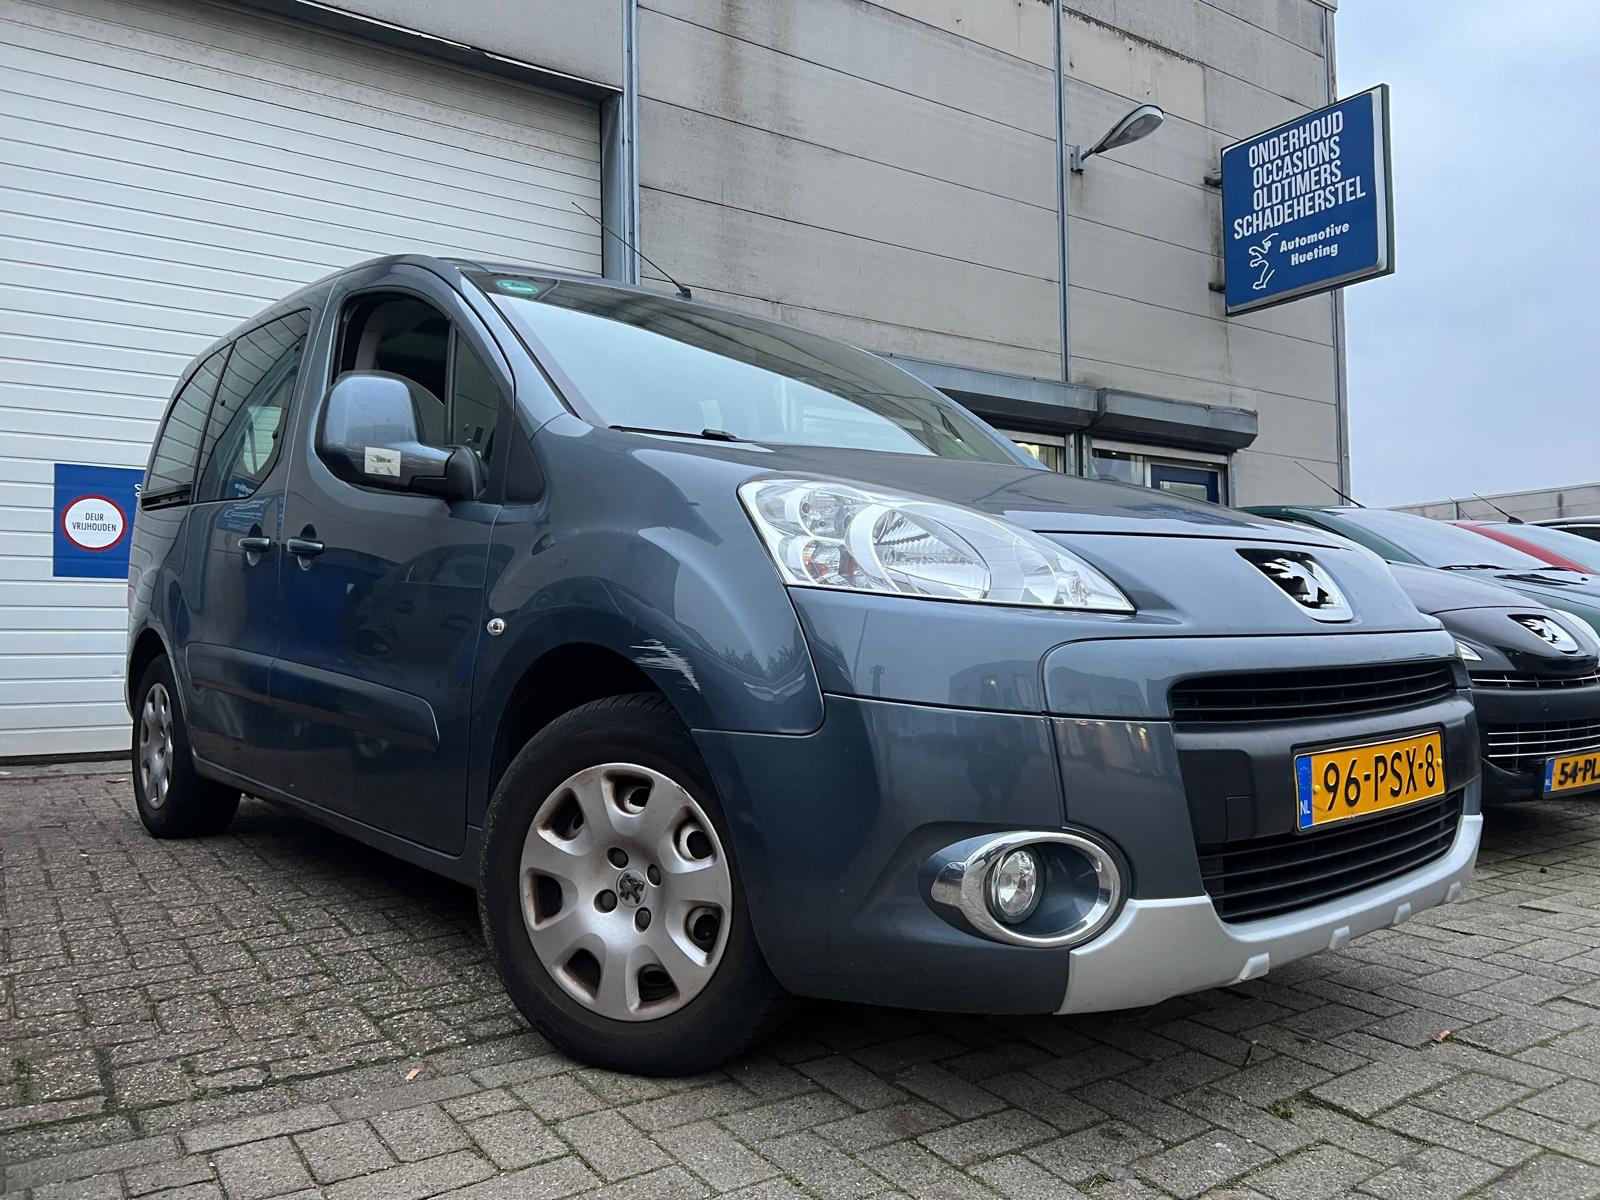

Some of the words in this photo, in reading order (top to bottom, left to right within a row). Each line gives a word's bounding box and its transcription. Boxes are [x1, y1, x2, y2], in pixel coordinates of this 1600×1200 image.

[1249, 110, 1344, 168] ONDERHOUD
[1252, 136, 1341, 189] OCCASIONS
[1233, 175, 1366, 240] SCHADEHERSTEL
[1253, 160, 1342, 211] OLDTIMERS
[1279, 222, 1350, 253] Automotive
[1290, 242, 1339, 266] Hueting
[72, 521, 117, 532] VRIJHOUDEN
[85, 512, 104, 521] DEUR
[1300, 799, 1311, 816] NL
[1323, 742, 1436, 812] 96-PSX-8
